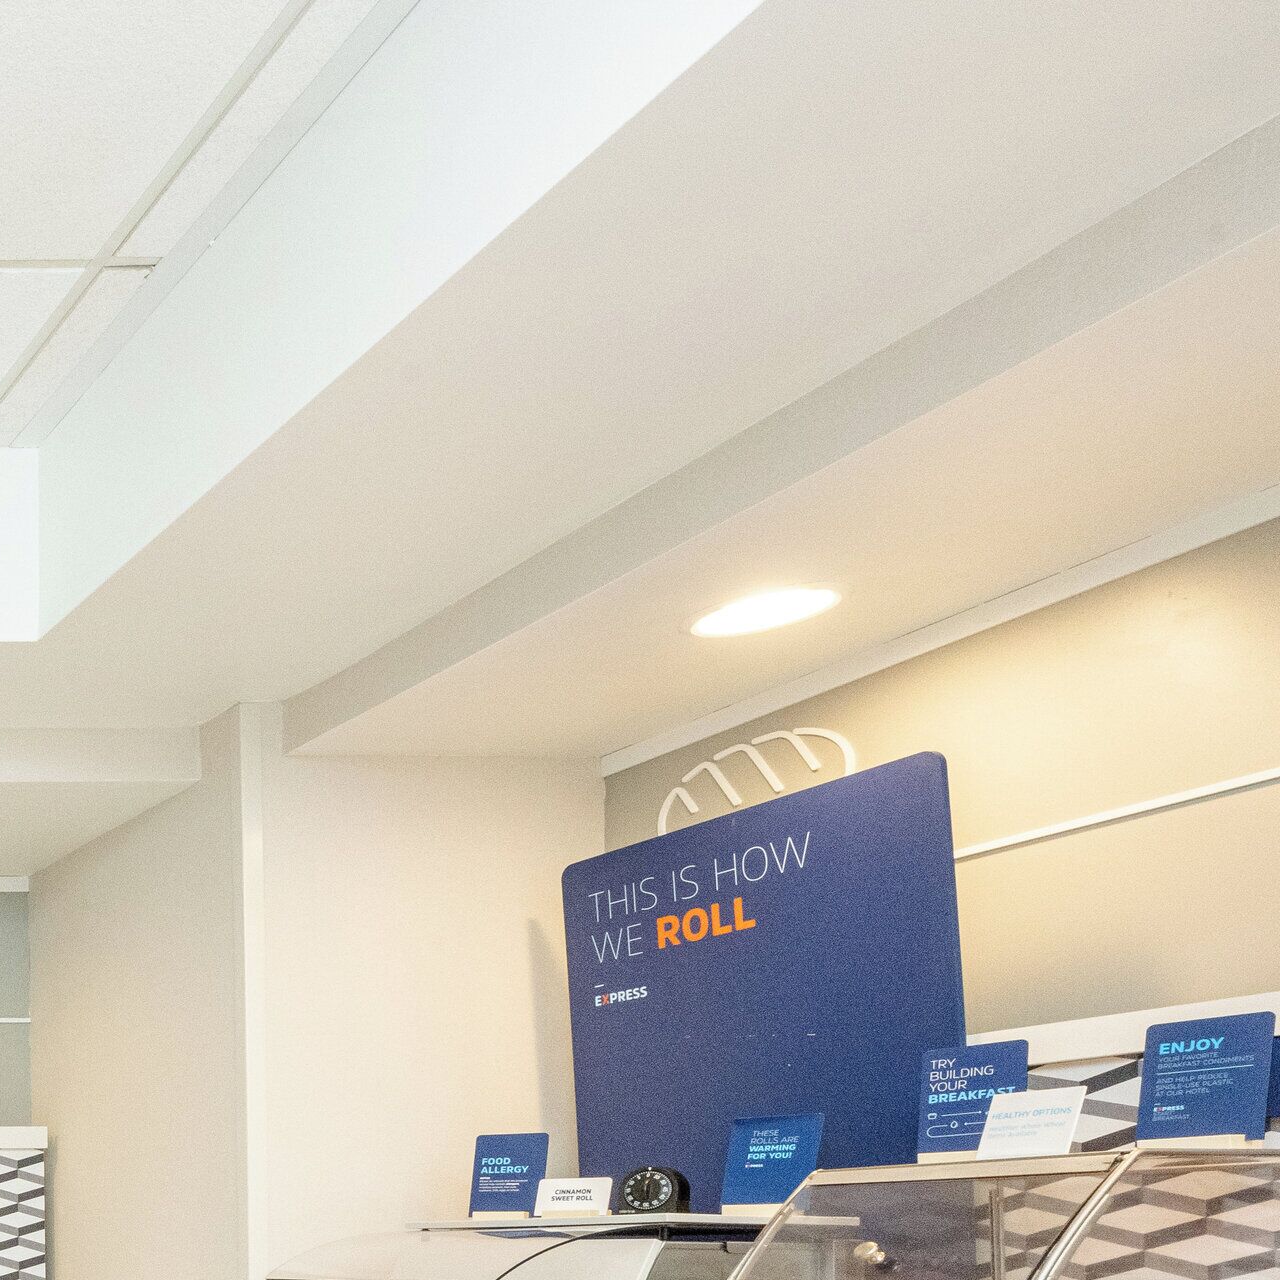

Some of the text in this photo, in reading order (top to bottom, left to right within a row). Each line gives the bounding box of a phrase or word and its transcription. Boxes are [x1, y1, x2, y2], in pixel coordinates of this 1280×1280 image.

[588, 831, 811, 922] THIS IS HOW
[590, 896, 757, 964] WE ROLL
[594, 986, 648, 1007] EXPRESS
[1159, 1036, 1225, 1055] ENJOY
[930, 1058, 957, 1070] TRY
[929, 1065, 995, 1082] BUILDING
[929, 1080, 968, 1093] YOUR
[992, 1106, 1072, 1120] HEALTHY OPTIONS
[753, 1129, 780, 1137] THESE
[750, 1135, 800, 1145] ROLLS ARE
[749, 1144, 797, 1152] WARMING
[481, 1157, 511, 1165] FOOD
[480, 1165, 530, 1174] ALLERGY
